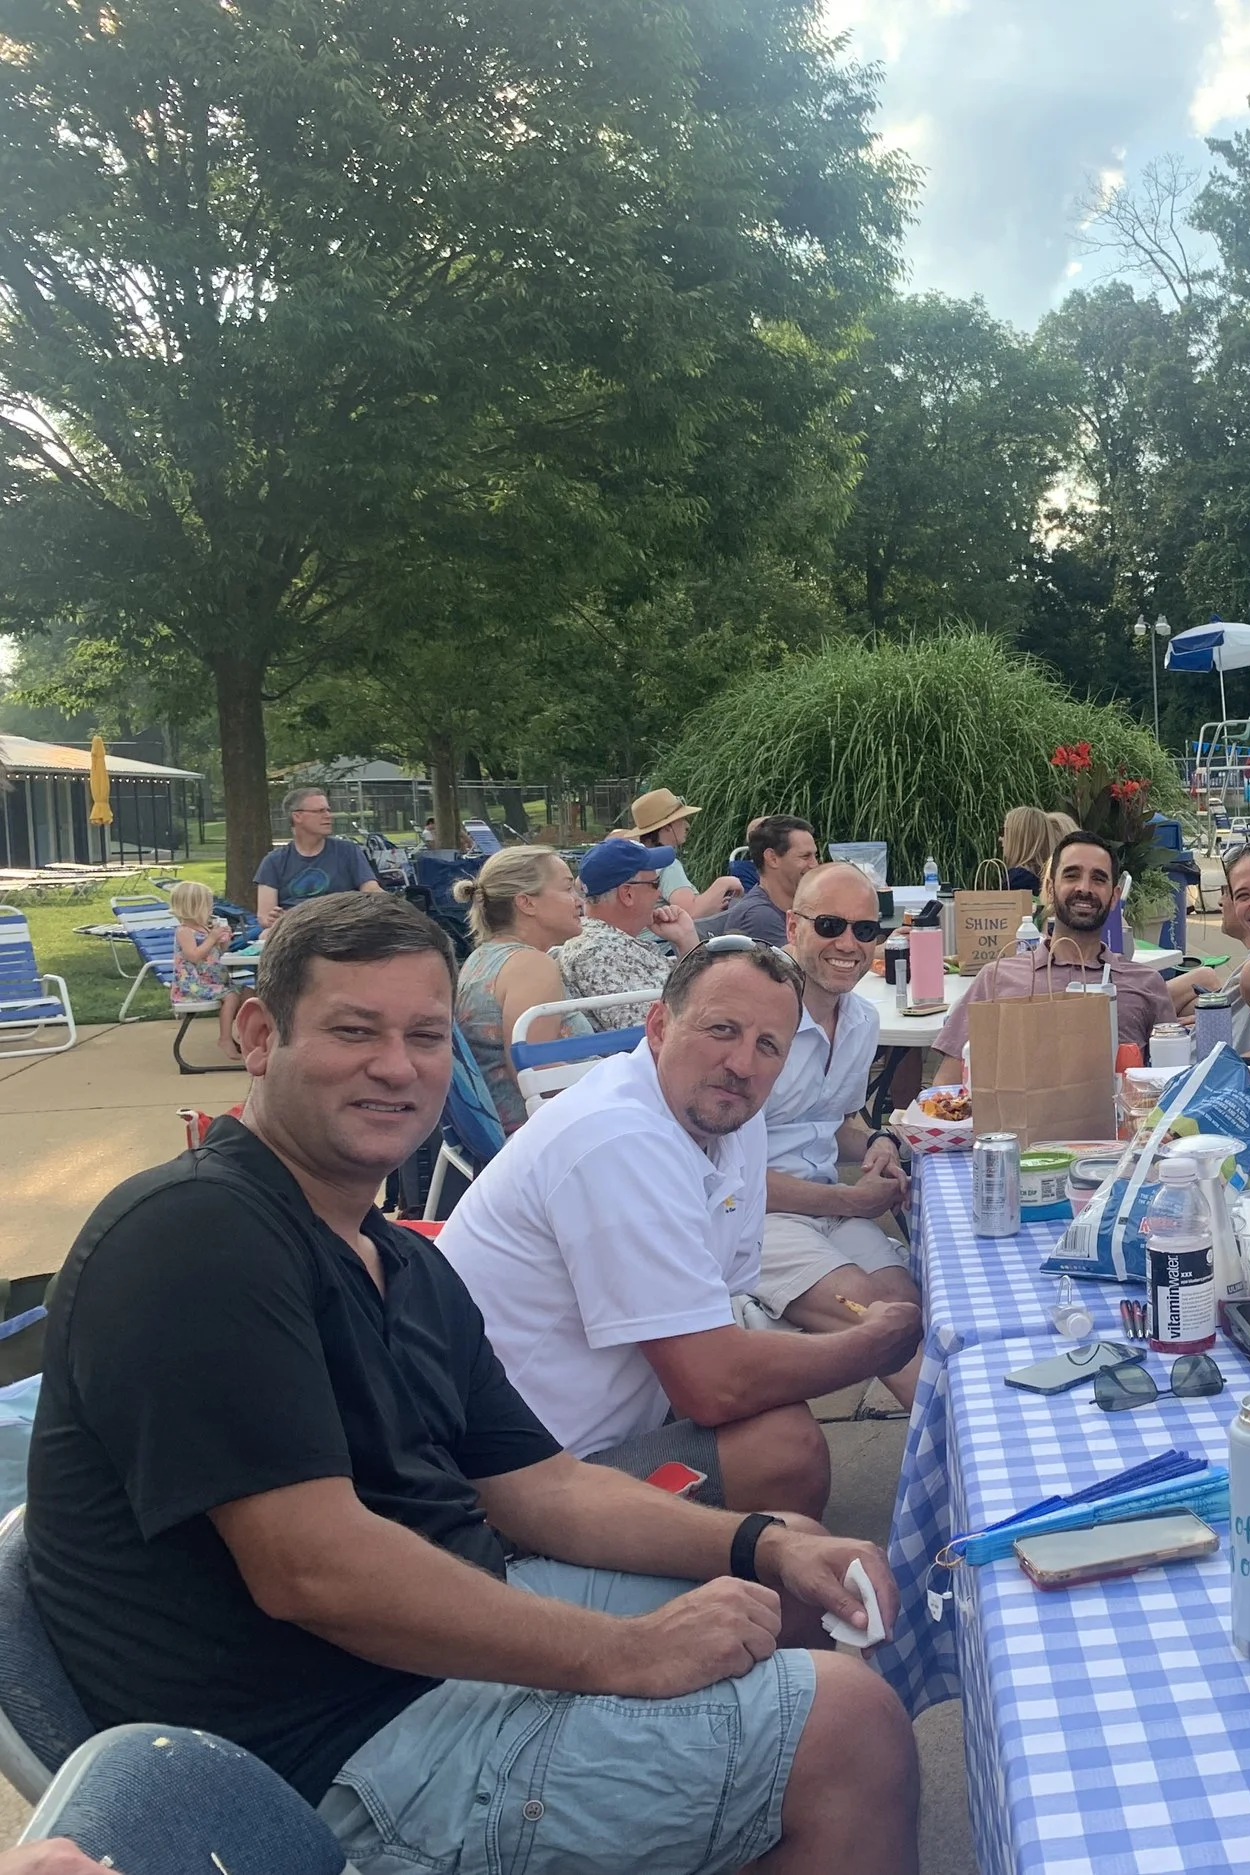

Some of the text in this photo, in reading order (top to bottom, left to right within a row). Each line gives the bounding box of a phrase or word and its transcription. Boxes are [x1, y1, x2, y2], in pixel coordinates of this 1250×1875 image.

[965, 917, 1008, 931] SHINE
[978, 935, 998, 948] ON
[1167, 1255, 1181, 1339] vitaminwater
